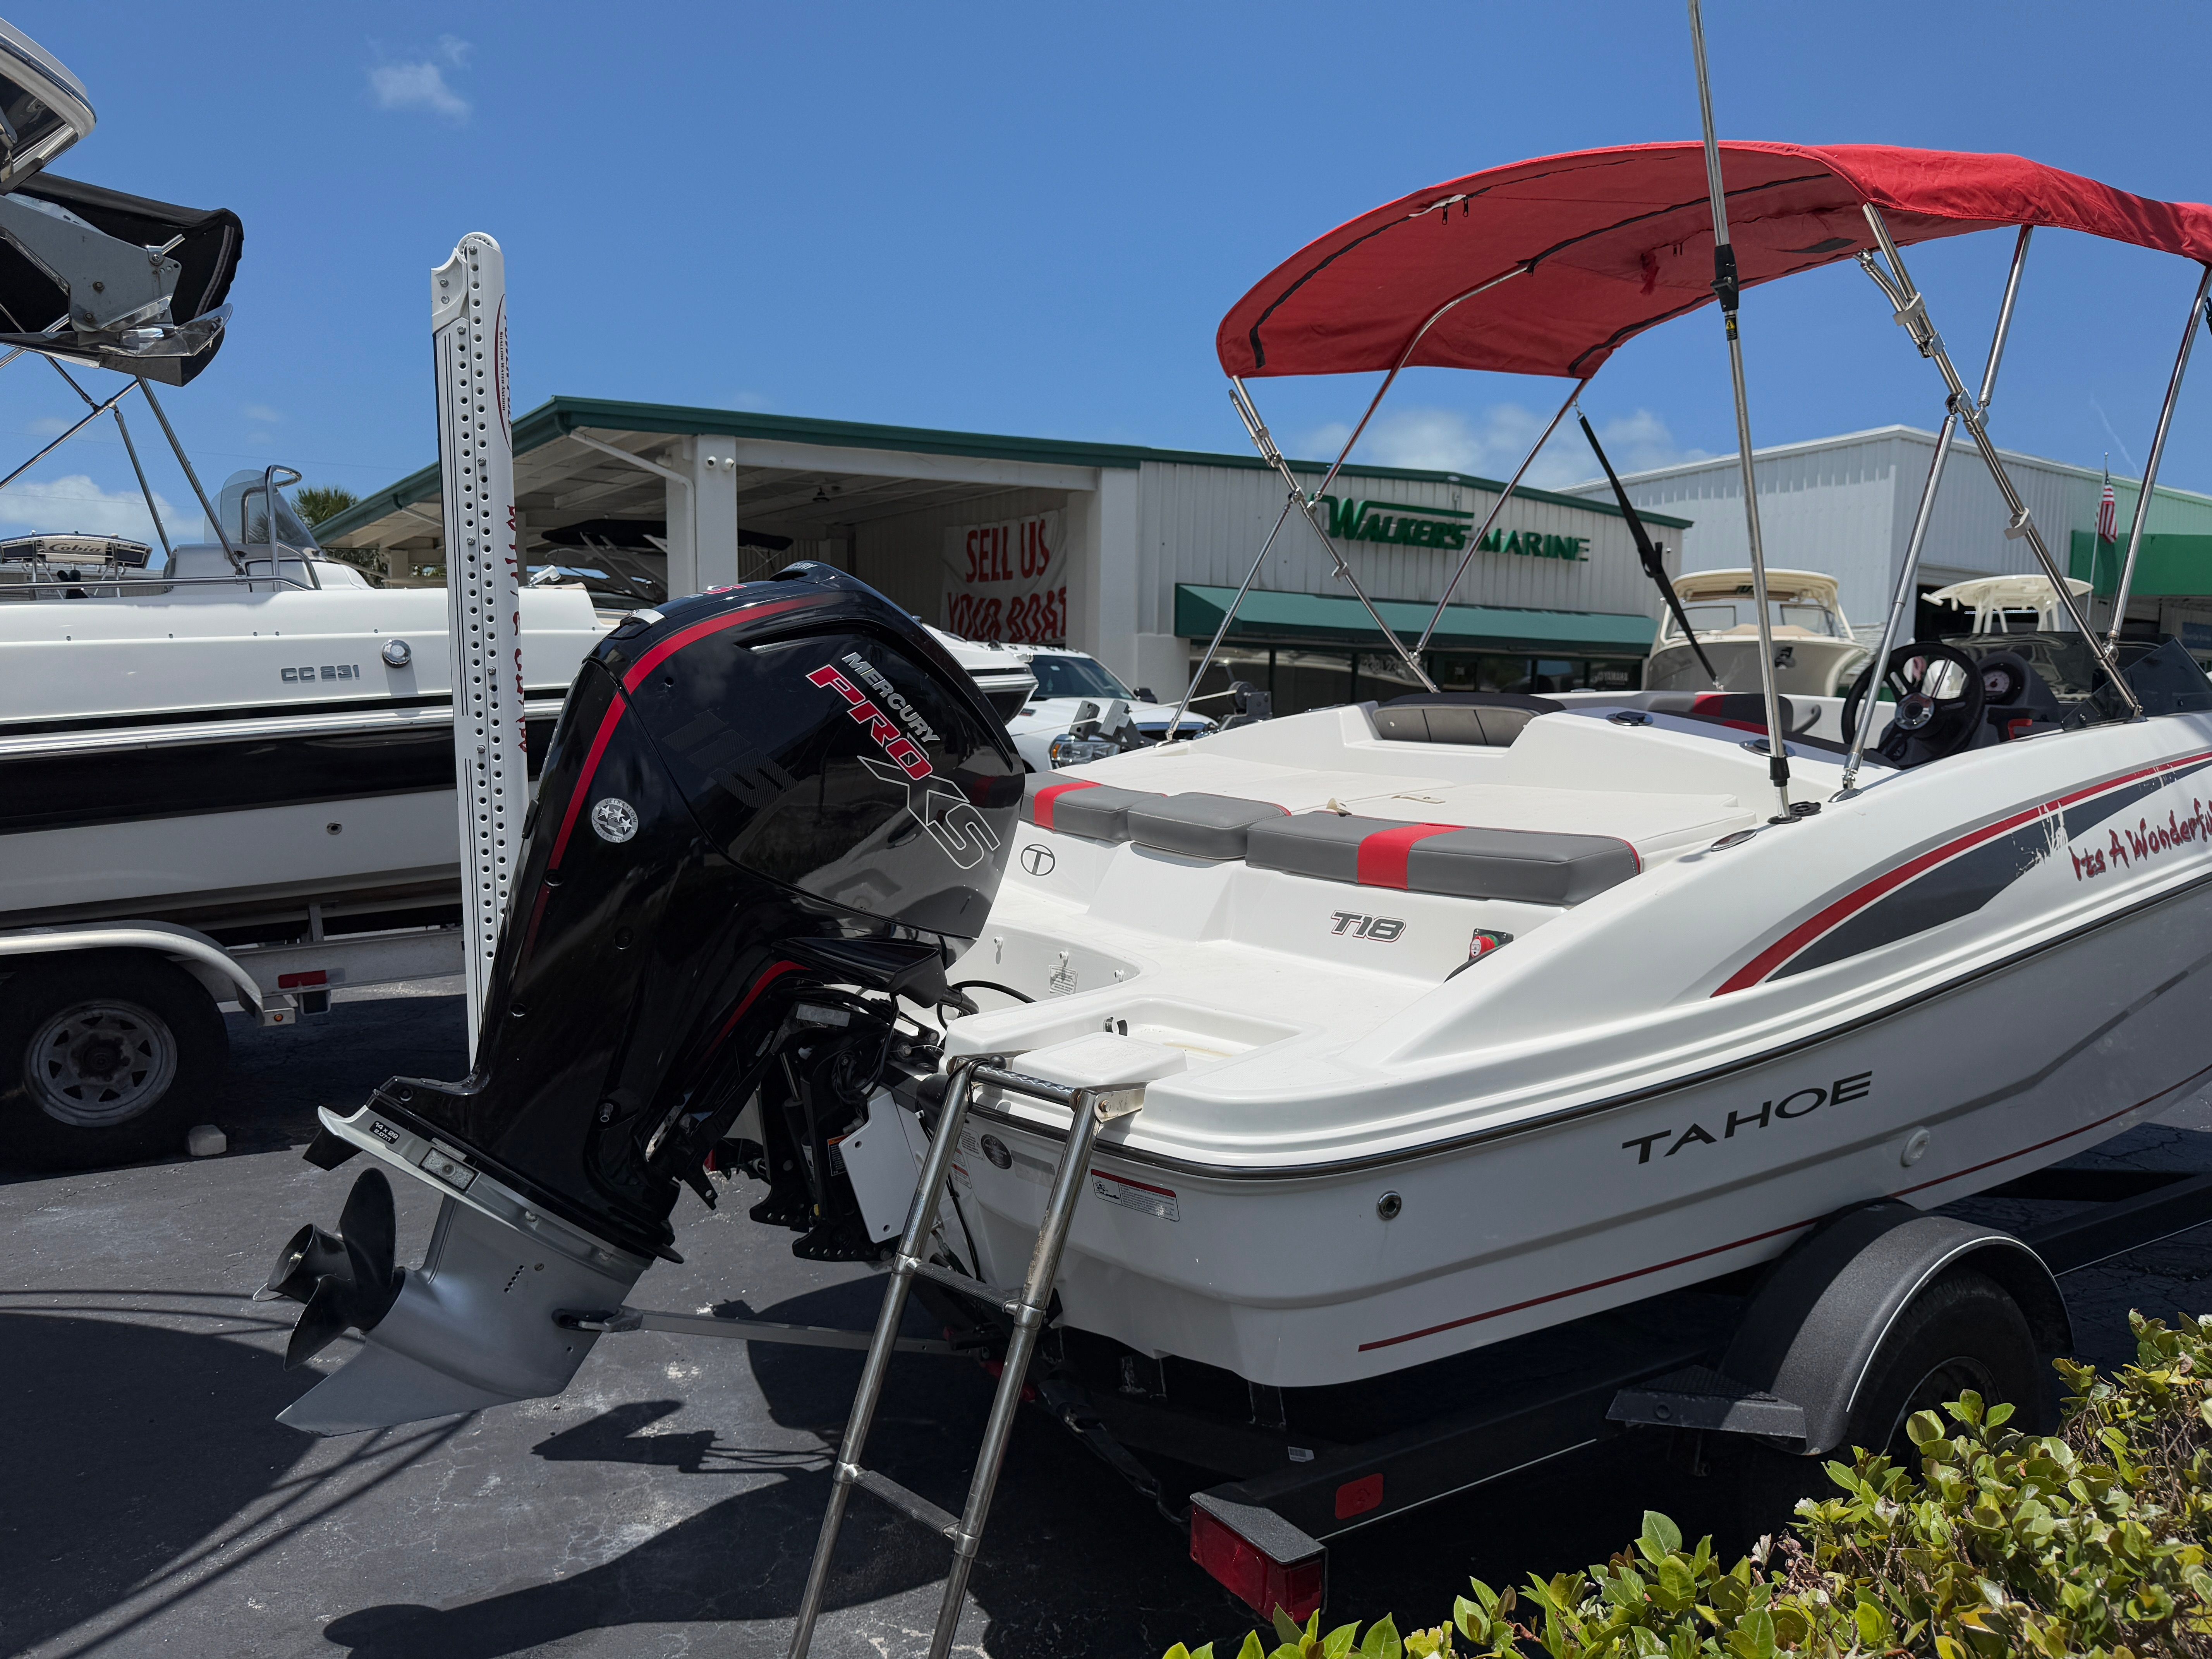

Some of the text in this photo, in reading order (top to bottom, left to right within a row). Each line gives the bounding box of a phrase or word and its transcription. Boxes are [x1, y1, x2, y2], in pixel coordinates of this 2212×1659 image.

[49, 543, 102, 553] Cobia
[965, 519, 1049, 583] SELL US
[1477, 527, 1590, 562] MARINE
[947, 592, 1002, 643] YOUR
[281, 665, 360, 681] CC 231
[841, 651, 941, 744] MERCURY
[805, 664, 1001, 869] PRO XS
[605, 799, 637, 823] ULTRA LOW
[2109, 829, 2130, 869] A
[1331, 910, 1406, 942] T18
[387, 1130, 398, 1139] 29
[1622, 1070, 1872, 1164] TAHOE
